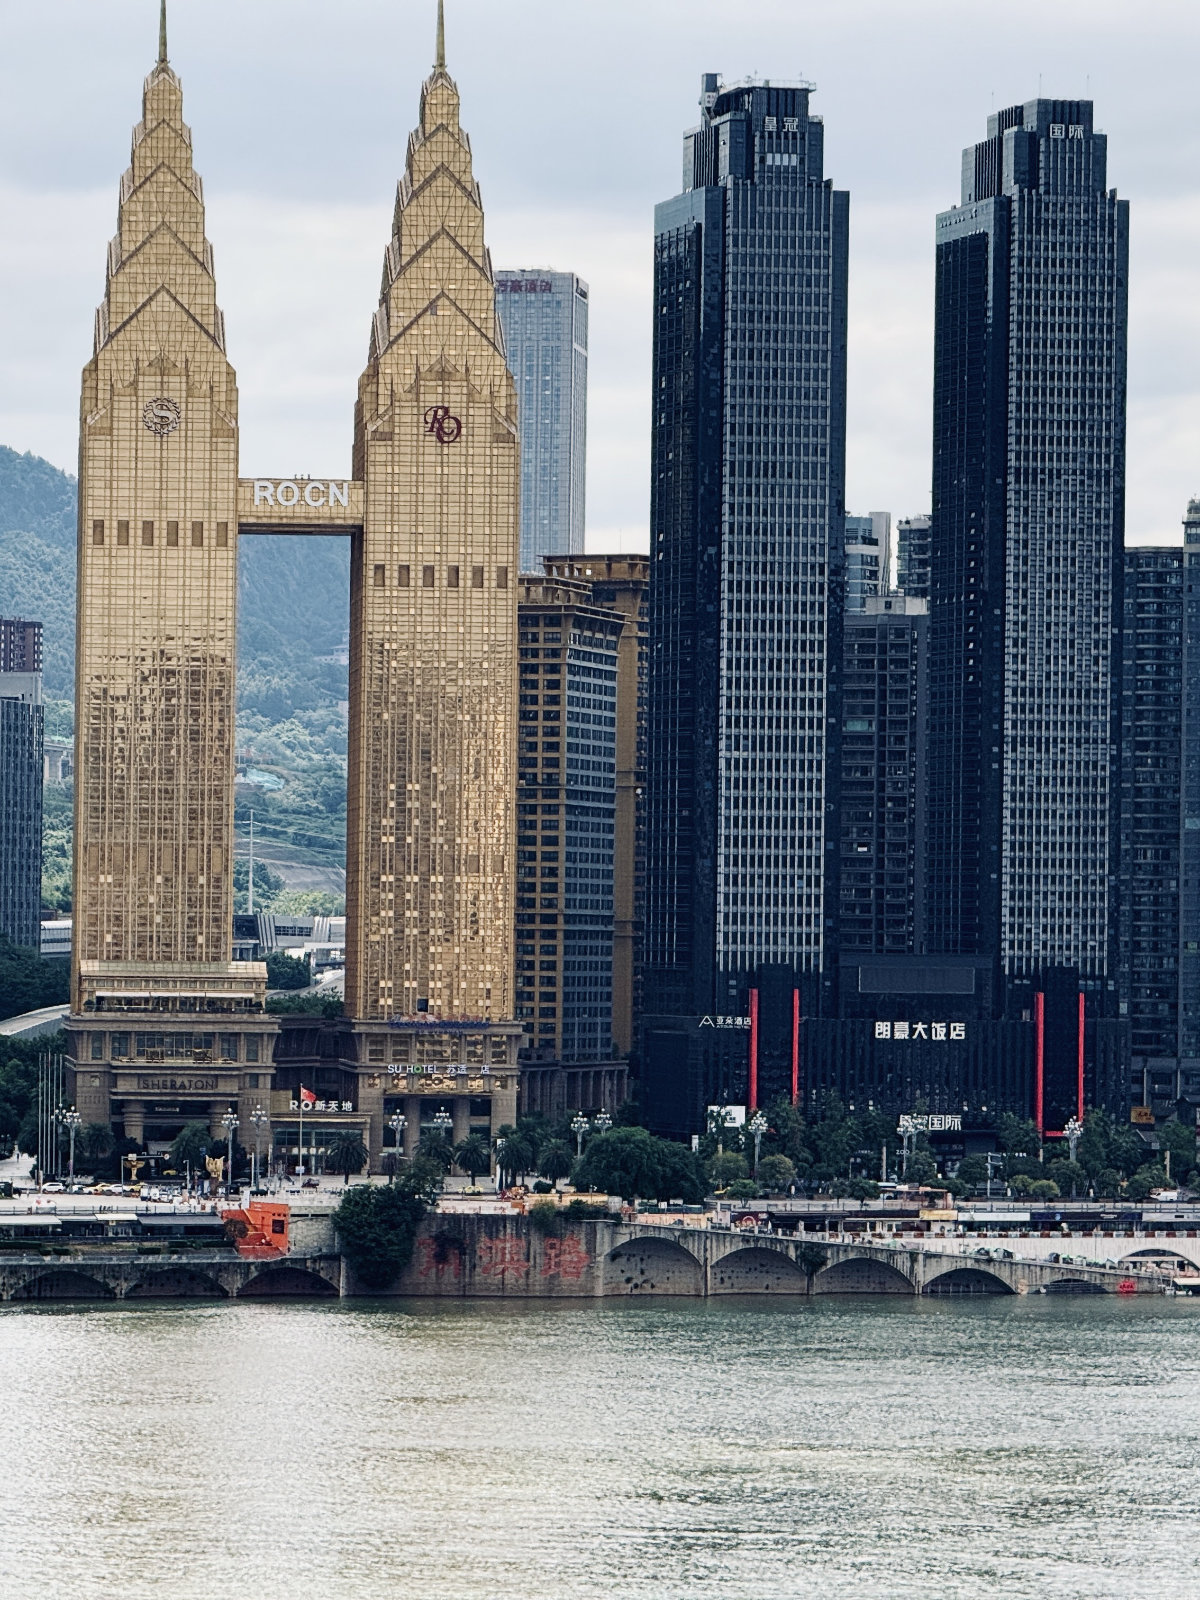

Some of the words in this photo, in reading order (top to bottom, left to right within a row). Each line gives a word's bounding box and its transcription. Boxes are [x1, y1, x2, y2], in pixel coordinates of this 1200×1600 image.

[764, 116, 798, 131] 皇冠
[1050, 123, 1084, 139] 国际
[716, 1016, 752, 1026] 亚朵酒店
[874, 1021, 966, 1040] 朗豪大饭店
[387, 1064, 401, 1074] SU
[406, 1065, 439, 1074] HOTEL
[142, 1079, 215, 1090] SHERATON
